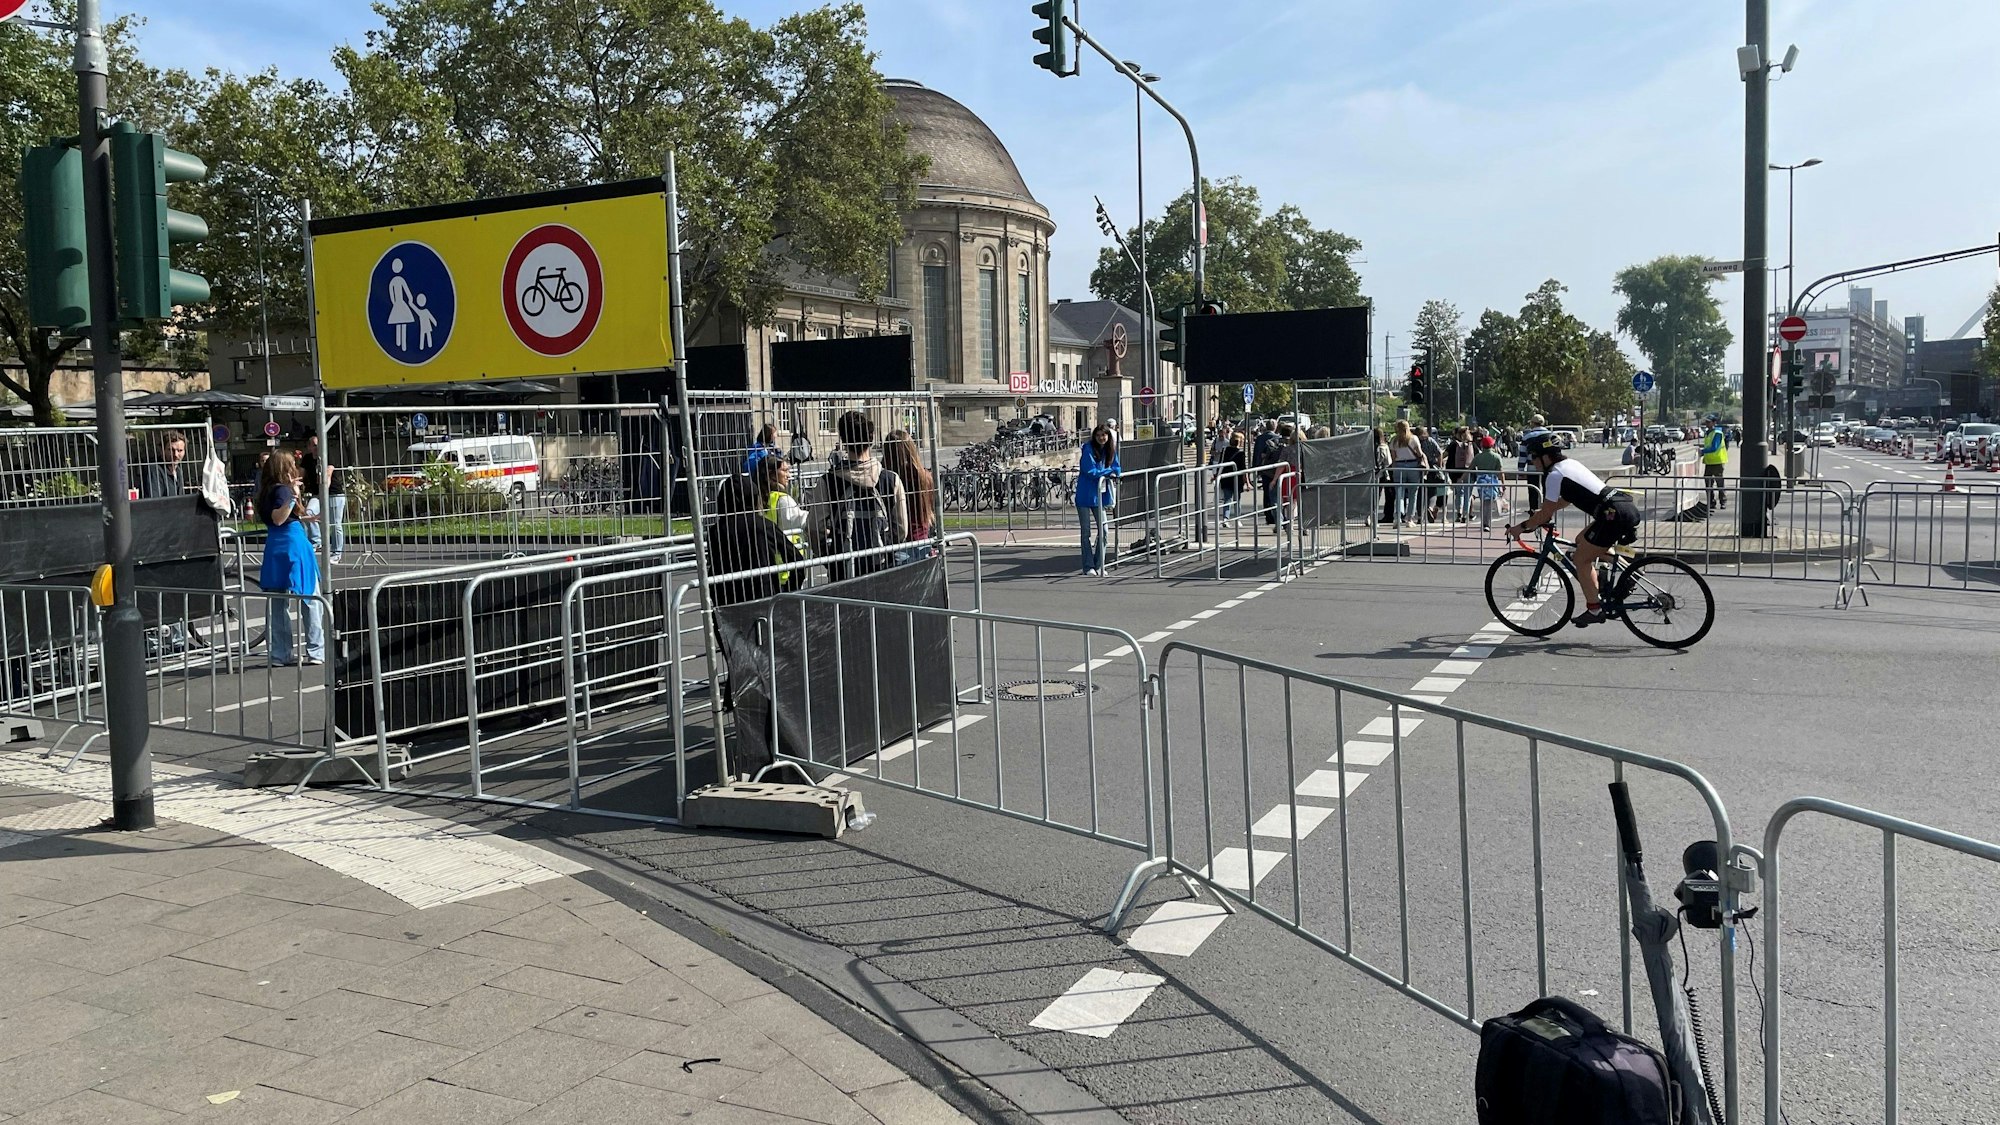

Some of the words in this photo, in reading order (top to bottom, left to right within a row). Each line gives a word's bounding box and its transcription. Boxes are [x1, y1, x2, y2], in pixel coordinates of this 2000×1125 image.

[1702, 264, 1738, 273] Auenweg
[1012, 375, 1029, 389] DB
[1039, 379, 1067, 394] KÖLN
